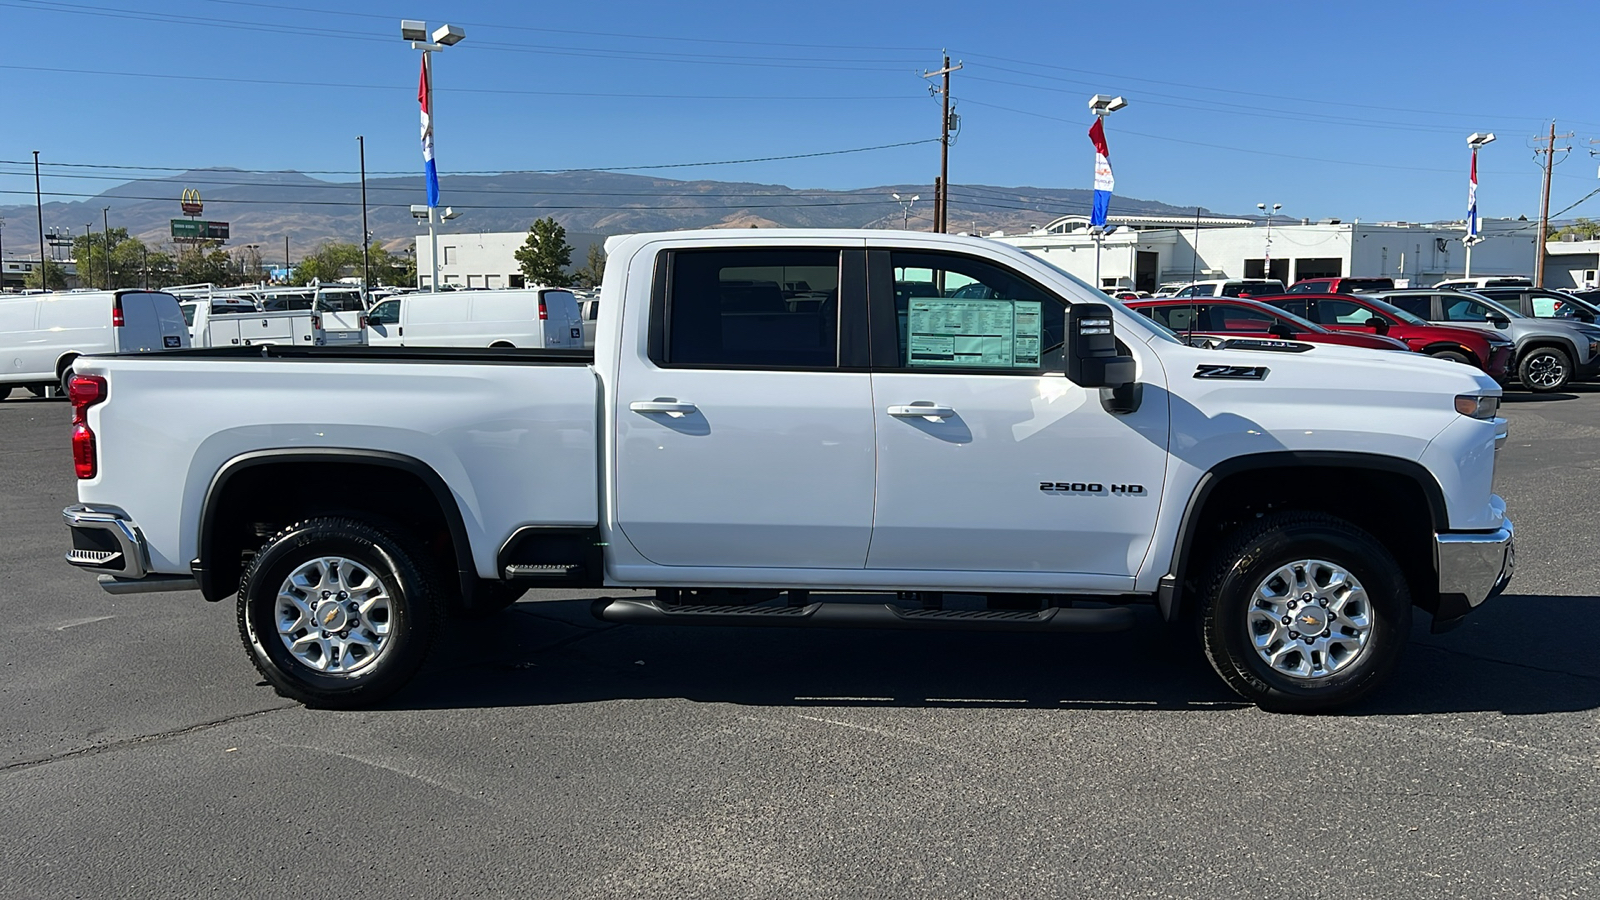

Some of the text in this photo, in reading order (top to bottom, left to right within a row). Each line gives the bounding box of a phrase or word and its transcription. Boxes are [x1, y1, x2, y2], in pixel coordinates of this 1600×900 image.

[1192, 364, 1271, 381] Z71
[1040, 482, 1144, 493] 2500 HD
